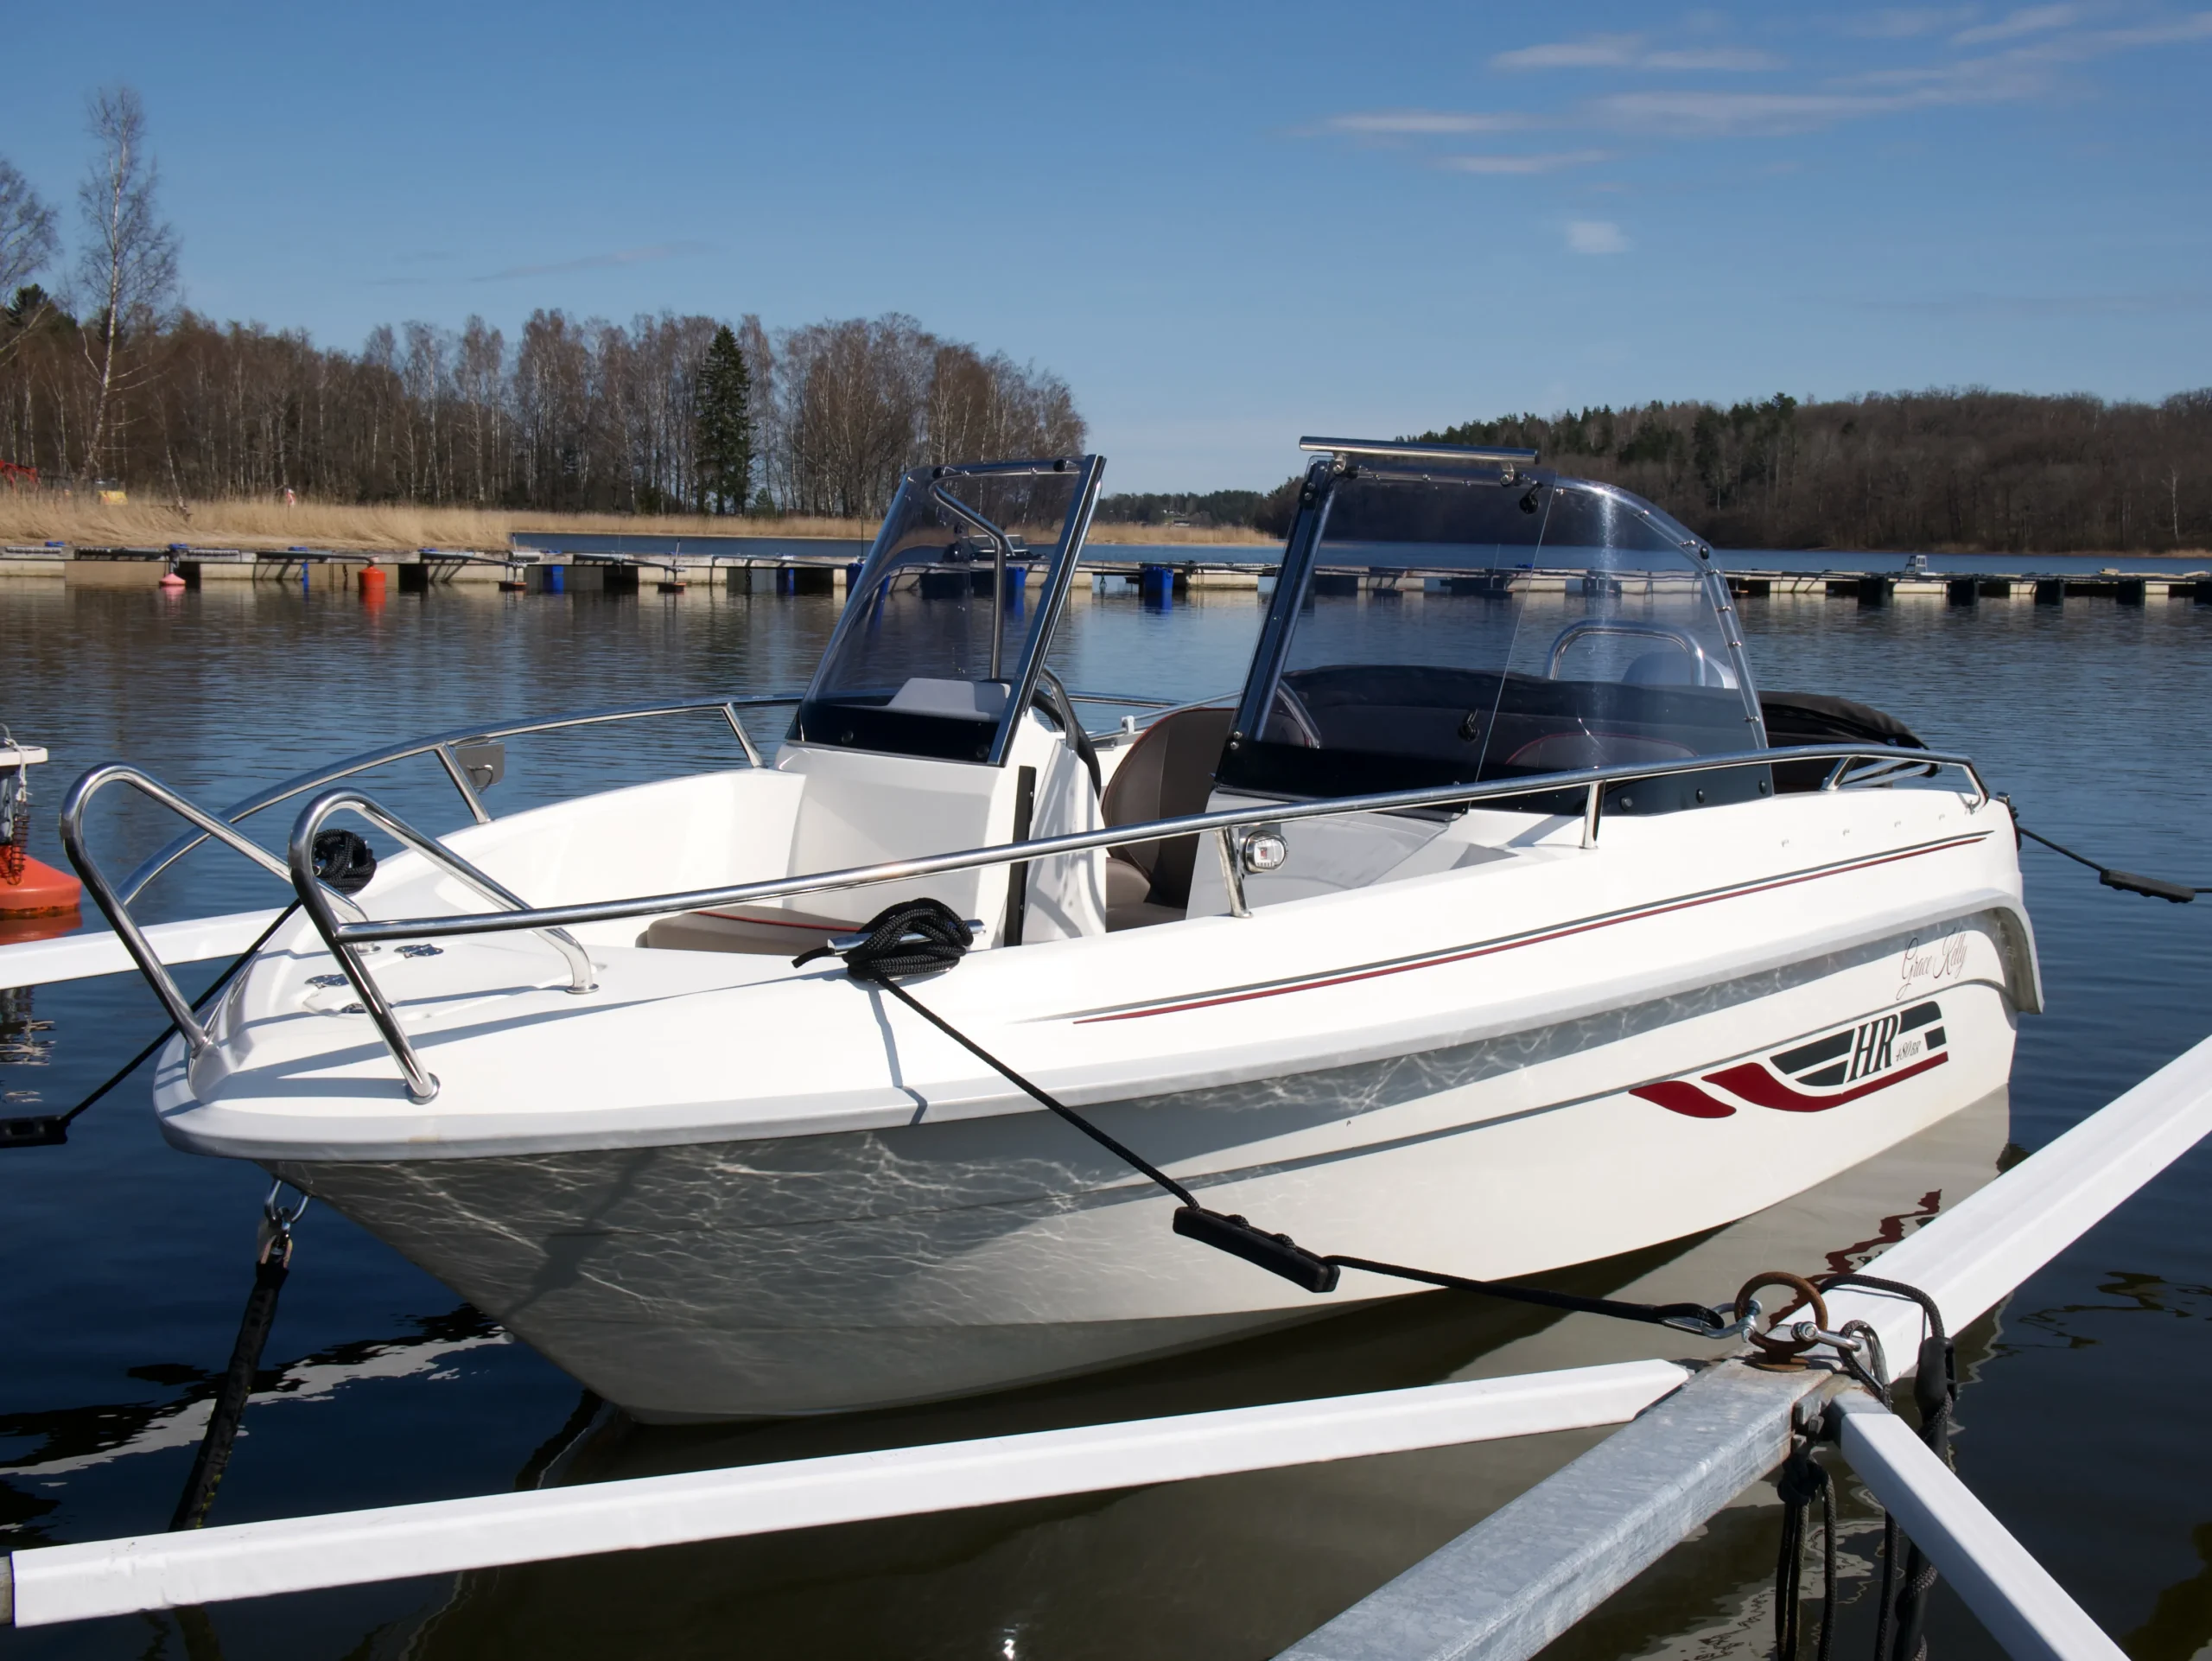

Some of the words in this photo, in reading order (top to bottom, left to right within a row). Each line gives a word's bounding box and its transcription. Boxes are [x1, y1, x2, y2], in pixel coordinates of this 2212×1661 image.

[1896, 938, 1932, 1001] Grace
[1933, 926, 1967, 979] Kelly
[1847, 1014, 1898, 1083] HR
